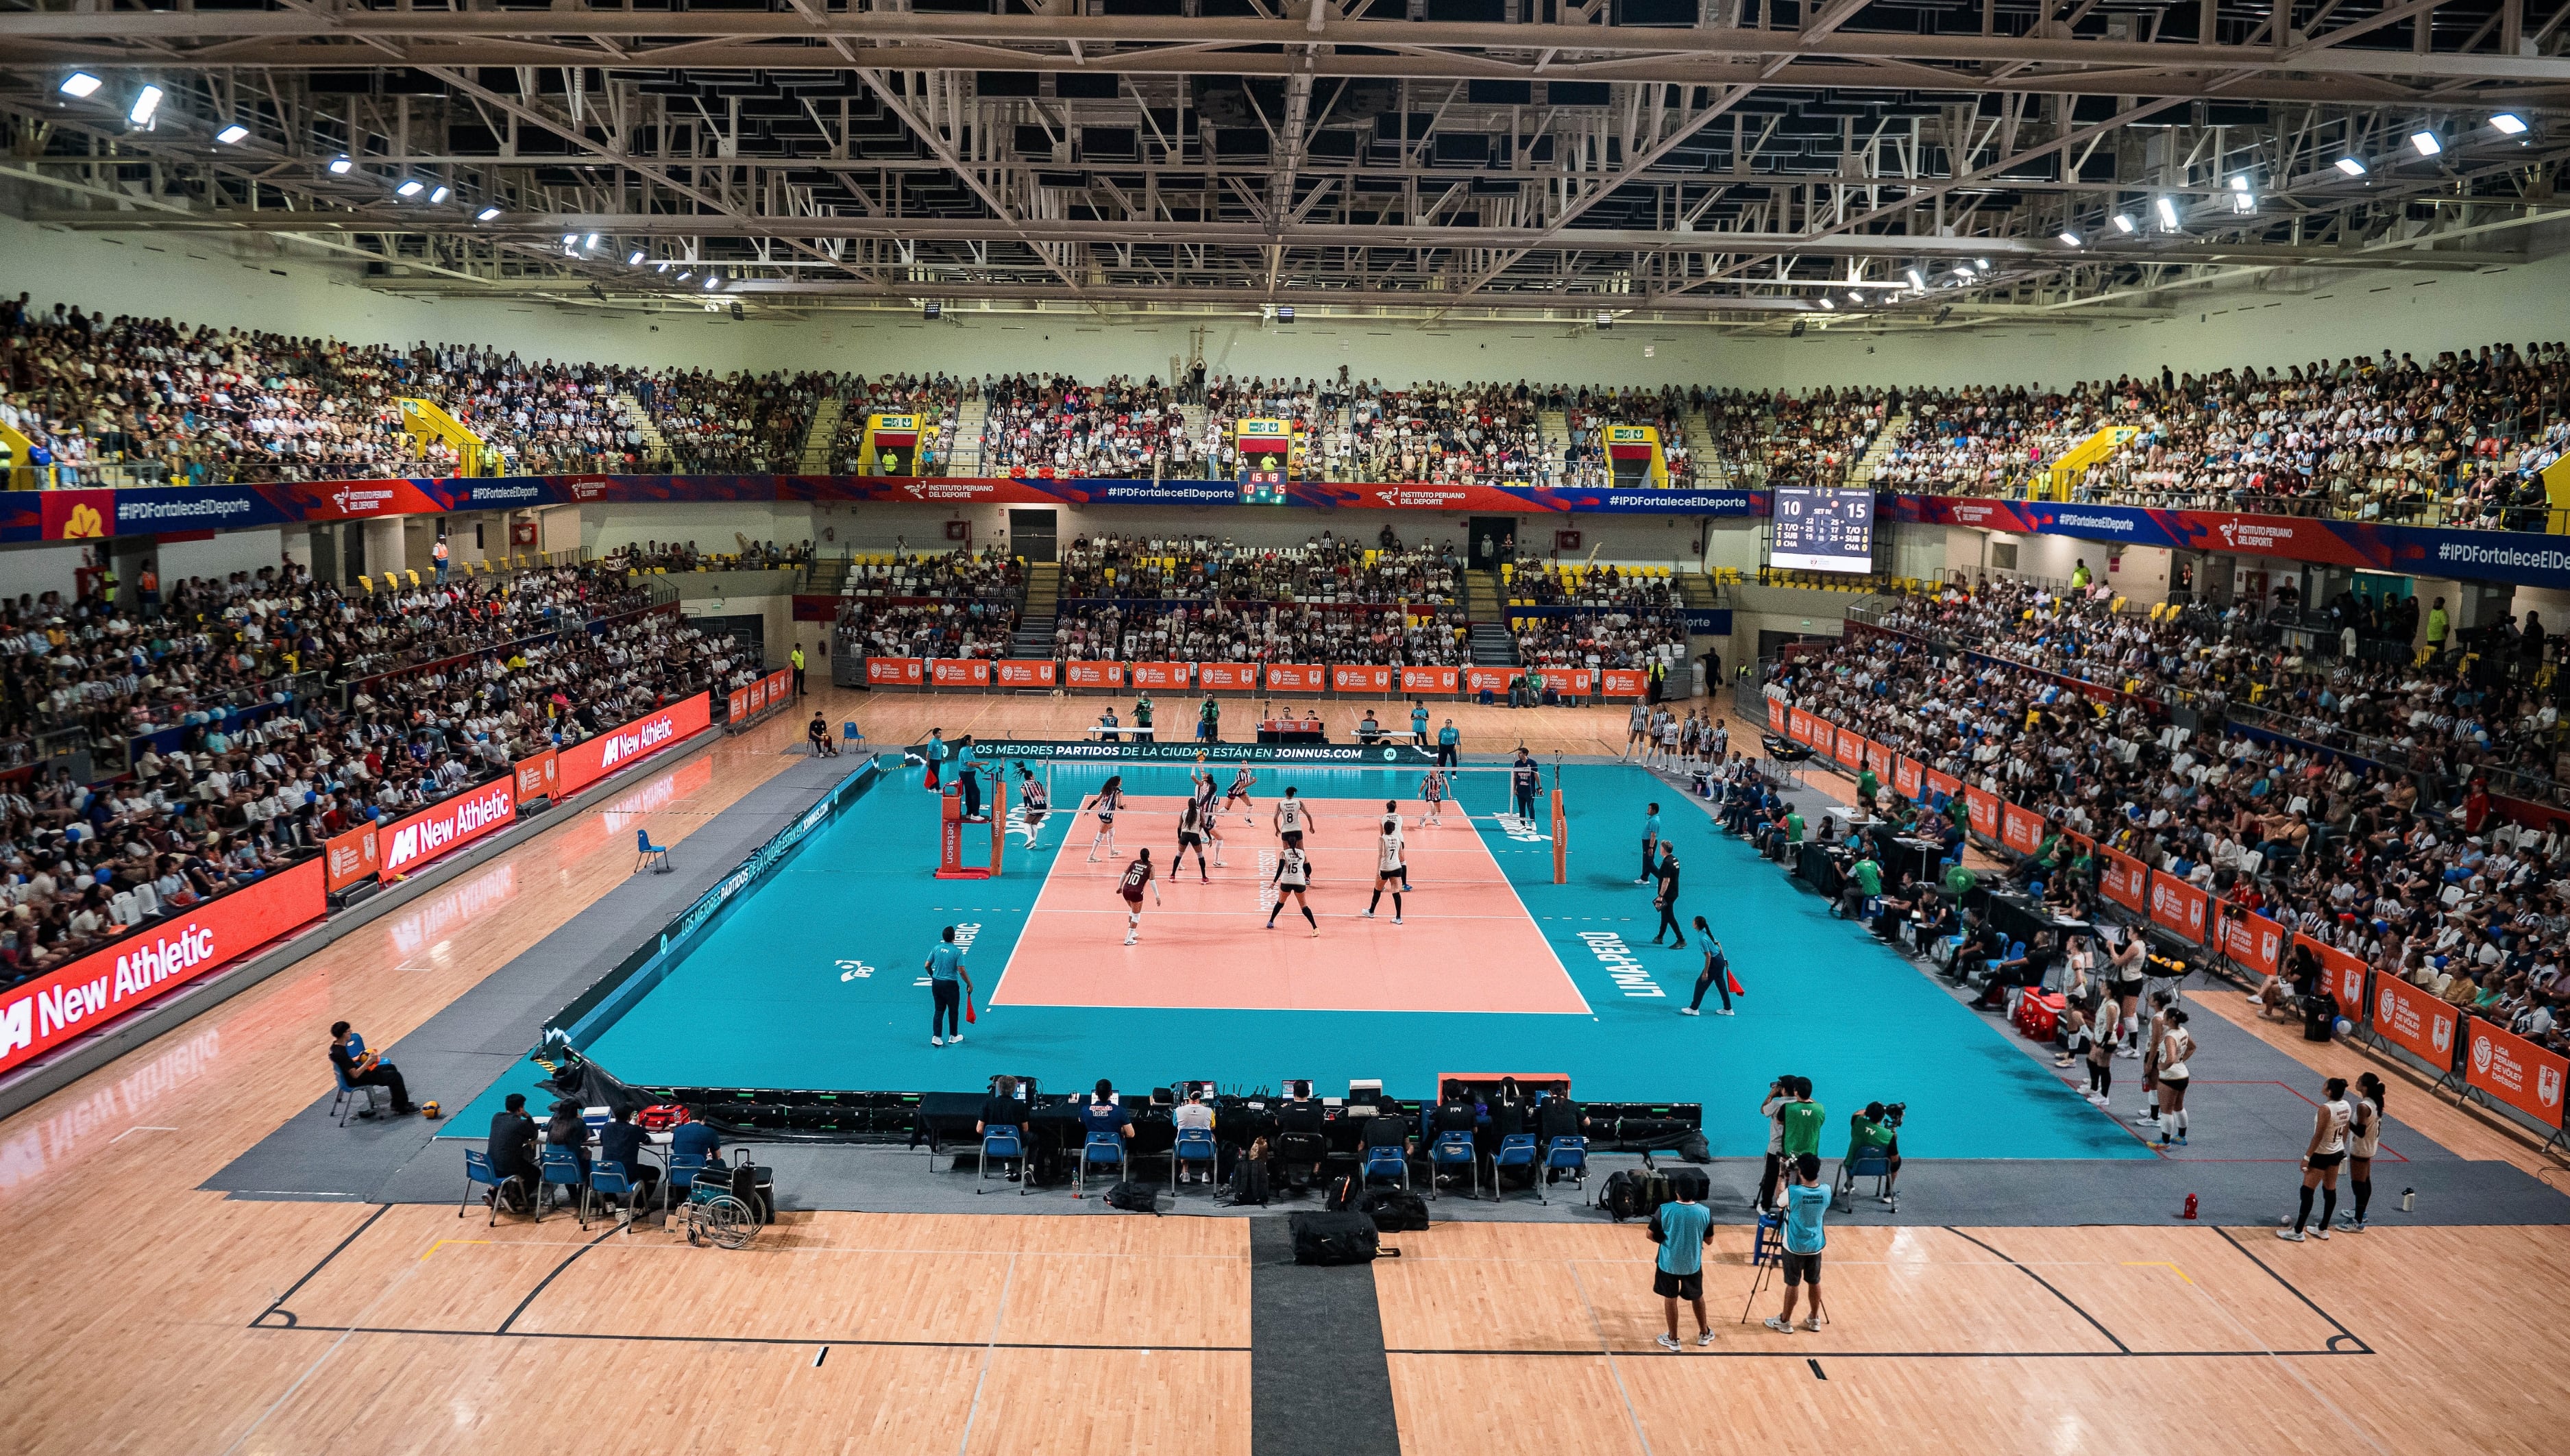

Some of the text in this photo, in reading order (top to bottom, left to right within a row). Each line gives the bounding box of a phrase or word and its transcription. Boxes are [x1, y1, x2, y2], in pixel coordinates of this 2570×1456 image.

[1252, 473, 1262, 482] 16
[1268, 473, 1278, 482] 18
[473, 486, 538, 502] #IPDFortaleceElDeporte
[1107, 487, 1234, 500] #IPDFortaleceElDeporte
[1244, 484, 1254, 493] 10
[1275, 484, 1285, 493] 15
[118, 498, 251, 519] #IPDFortaleceElDeporte
[1609, 495, 1746, 509] #IPDFortaleceElDeporte
[1783, 500, 1800, 515] 10
[1847, 503, 1865, 518] 15
[2059, 513, 2134, 532] #IPDFortaleceElDeporte
[2238, 525, 2292, 538] INSTITUTO PERUANO
[2238, 535, 2273, 547] DEL DEPORTE
[620, 715, 672, 759] New Athletic
[996, 745, 1053, 754] MEJORES
[1055, 746, 1119, 755] PARTIDOS
[1122, 747, 1139, 756] DE
[1142, 747, 1158, 756] LA
[1213, 745, 1252, 758] ESTÁN
[1255, 748, 1273, 758] EN
[1275, 748, 1362, 758] JOINNUS.COM
[419, 788, 509, 854] New Athletic
[1287, 813, 1293, 823] 8
[946, 822, 955, 864] betsson
[1390, 849, 1395, 860] 7
[681, 801, 828, 937] LOS MEJORES PARTIDOS DE LA CIUDAD ESTÁN EN JOINNUS.COM
[1288, 863, 1298, 874] 15
[1128, 873, 1140, 885] 10
[2232, 919, 2242, 928] LIGA
[2231, 932, 2252, 946] DE VÓLEY
[2232, 926, 2251, 938] PERUANA
[2231, 941, 2252, 954] betsson
[1576, 932, 1666, 997] LIMA-PERÚ
[38, 923, 215, 1037] New Athletic
[2397, 996, 2409, 1008] LIGA
[2395, 1012, 2420, 1030] DE VÓLEY
[2396, 1006, 2420, 1022] PERUANA
[2394, 1022, 2419, 1039] betsson
[2495, 1044, 2508, 1057] LIGA
[2494, 1053, 2522, 1072] PERUANA
[2493, 1062, 2522, 1083] DE VÓLEY
[2491, 1071, 2521, 1092] betsson
[1865, 1126, 1876, 1135] TV
